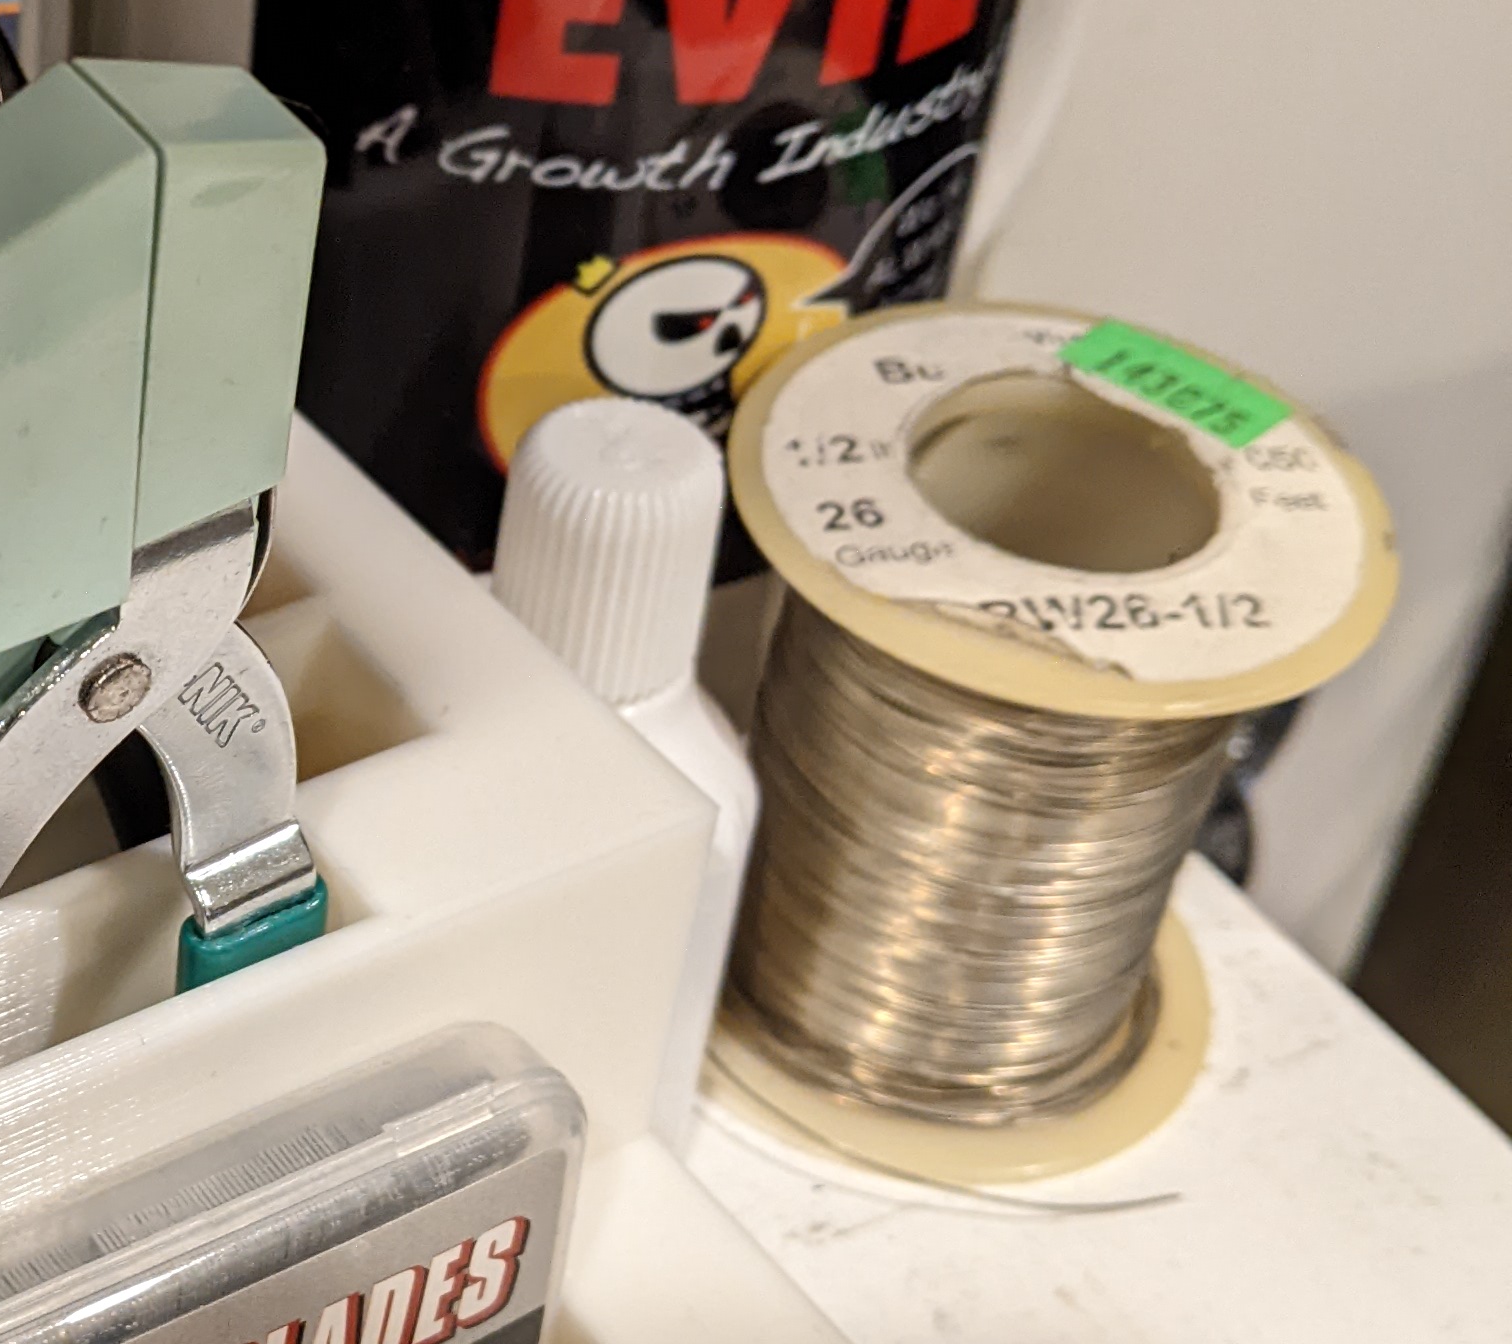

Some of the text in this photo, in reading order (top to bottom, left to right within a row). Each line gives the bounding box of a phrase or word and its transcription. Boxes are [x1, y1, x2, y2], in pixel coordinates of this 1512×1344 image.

[354, 103, 418, 165] A
[437, 123, 738, 192] Growth
[816, 498, 885, 532] 26
